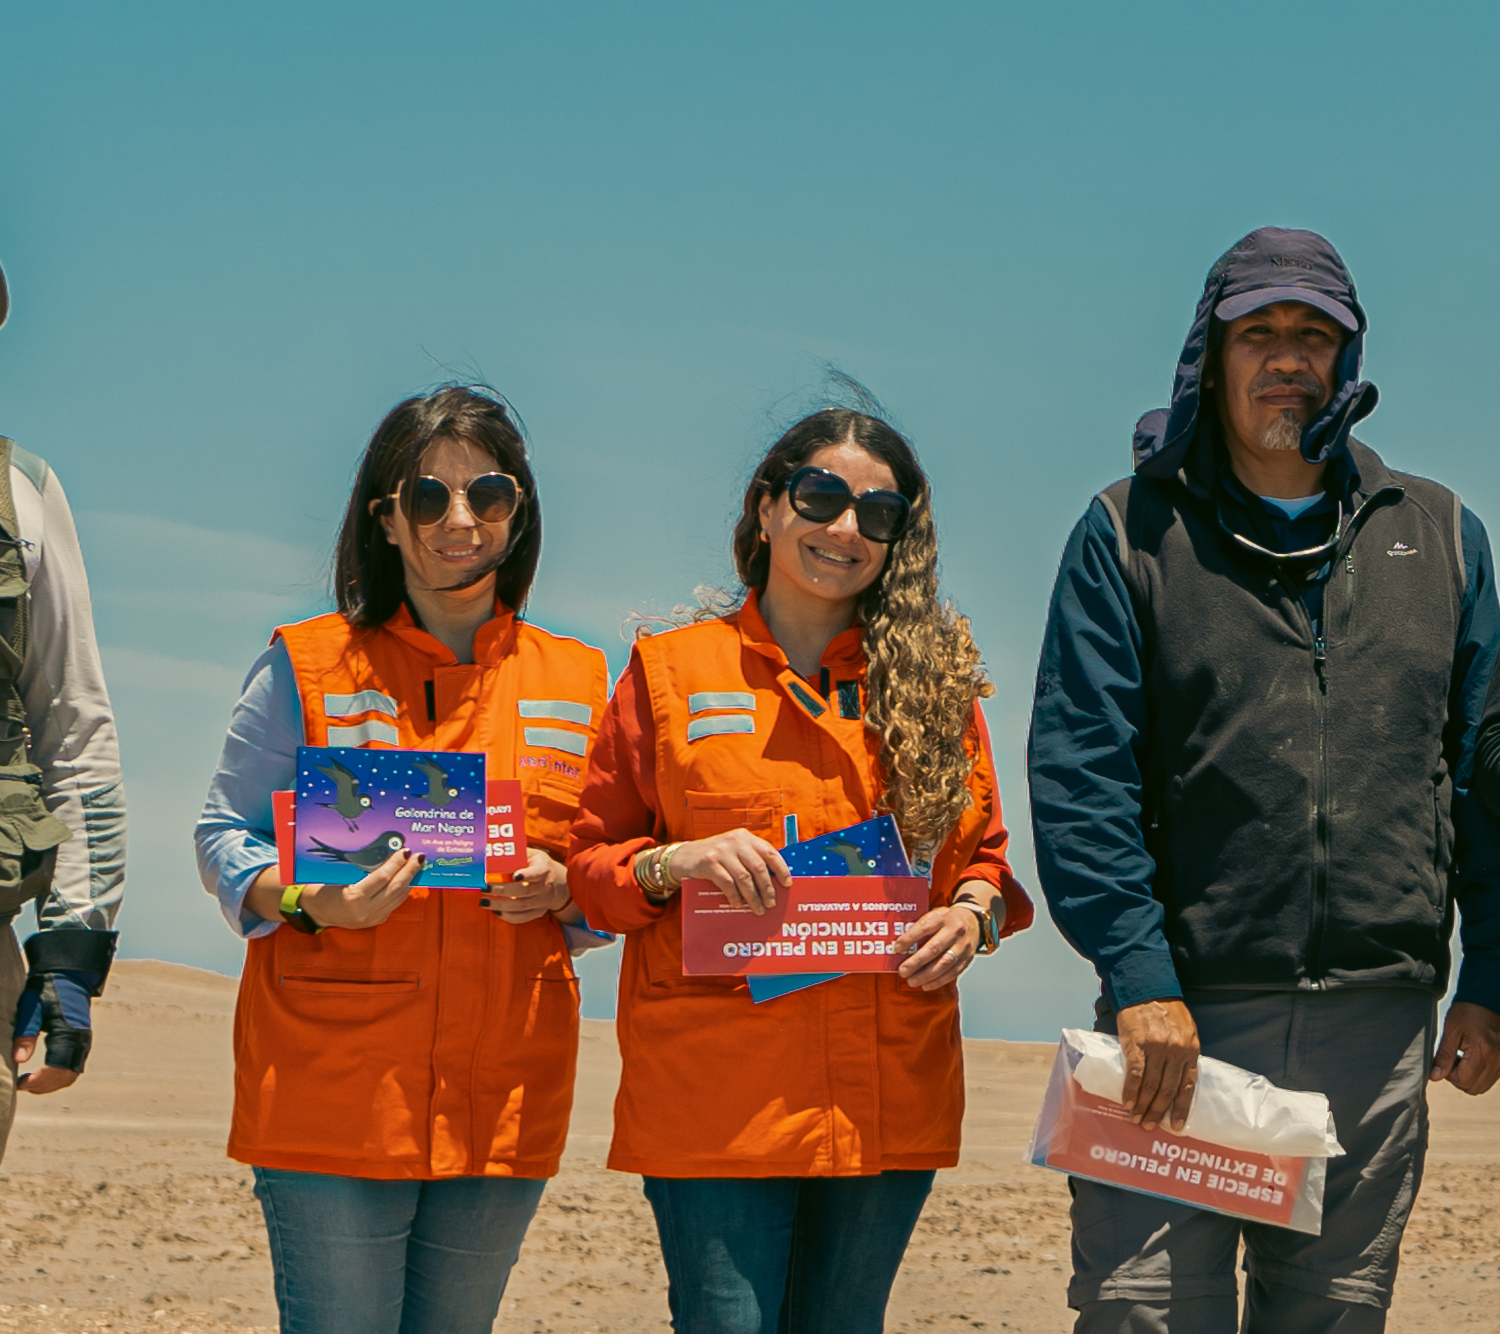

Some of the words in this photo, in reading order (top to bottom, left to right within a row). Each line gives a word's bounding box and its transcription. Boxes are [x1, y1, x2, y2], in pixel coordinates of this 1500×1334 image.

[395, 806, 457, 820] Golondrina
[459, 809, 474, 820] de
[411, 821, 435, 833] Mar
[438, 822, 474, 837] Negra
[488, 823, 514, 839] DE
[797, 902, 850, 912] SALVARLA!
[852, 902, 859, 911] A
[861, 902, 917, 913] ¡AYÚDANOS
[781, 921, 889, 942] EXTINCIÓN
[722, 941, 806, 958] PELIGRO
[812, 940, 838, 956] EN
[844, 940, 918, 956] EPECIE
[1089, 1144, 1174, 1177] PELIGRO
[1151, 1139, 1258, 1179] EXTINCIÓN
[1175, 1165, 1203, 1185] EN
[1261, 1167, 1288, 1187] DE
[1206, 1173, 1285, 1206] ESPECIE
